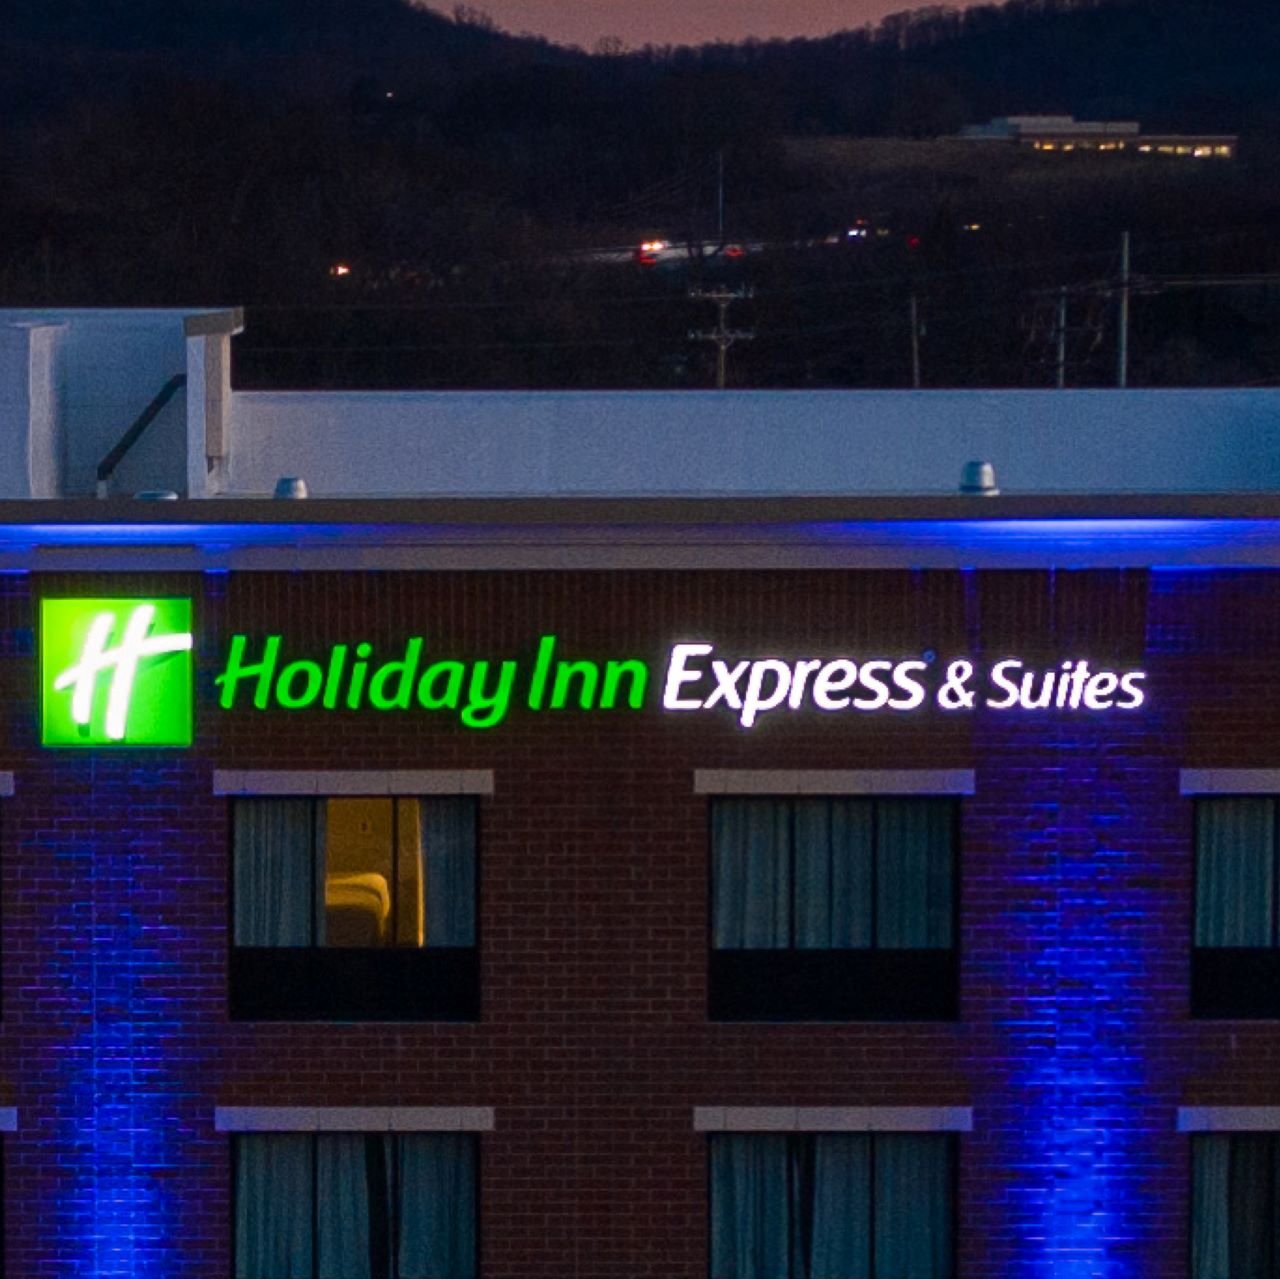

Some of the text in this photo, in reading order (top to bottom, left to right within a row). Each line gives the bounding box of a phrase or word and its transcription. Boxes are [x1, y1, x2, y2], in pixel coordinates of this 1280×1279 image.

[215, 635, 1146, 728] Holiday Inn Express & Suites
